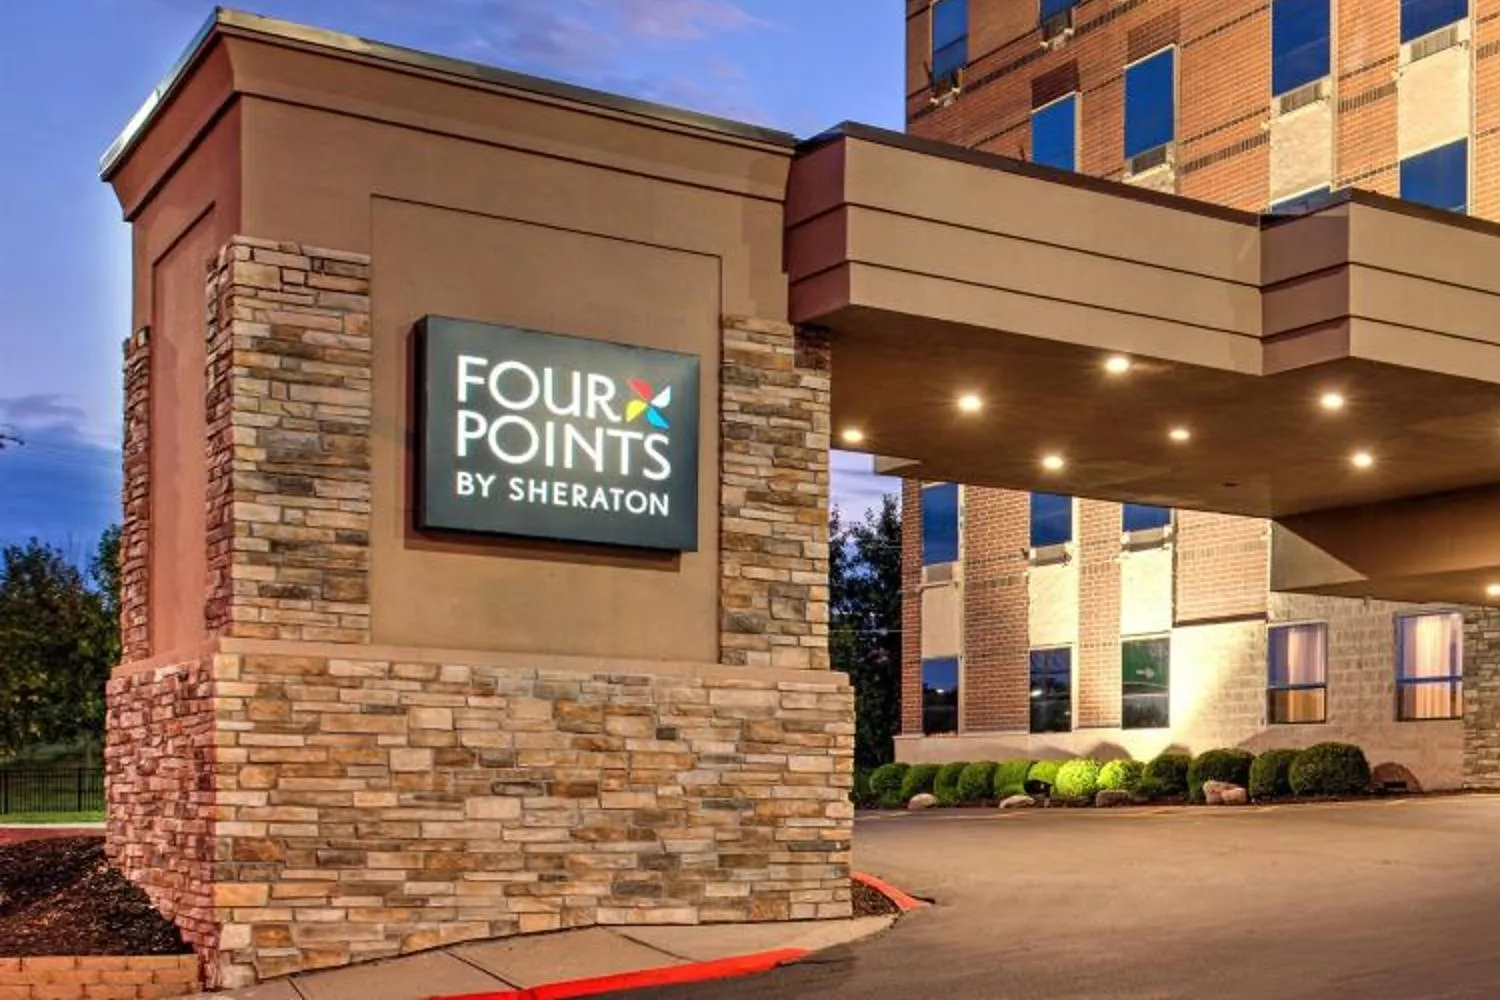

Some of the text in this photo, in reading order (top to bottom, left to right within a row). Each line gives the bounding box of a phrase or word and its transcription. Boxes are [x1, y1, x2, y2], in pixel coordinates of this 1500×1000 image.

[457, 354, 621, 422] FOUR
[457, 410, 671, 480] POINTS
[457, 471, 669, 516] BY SHERATON
